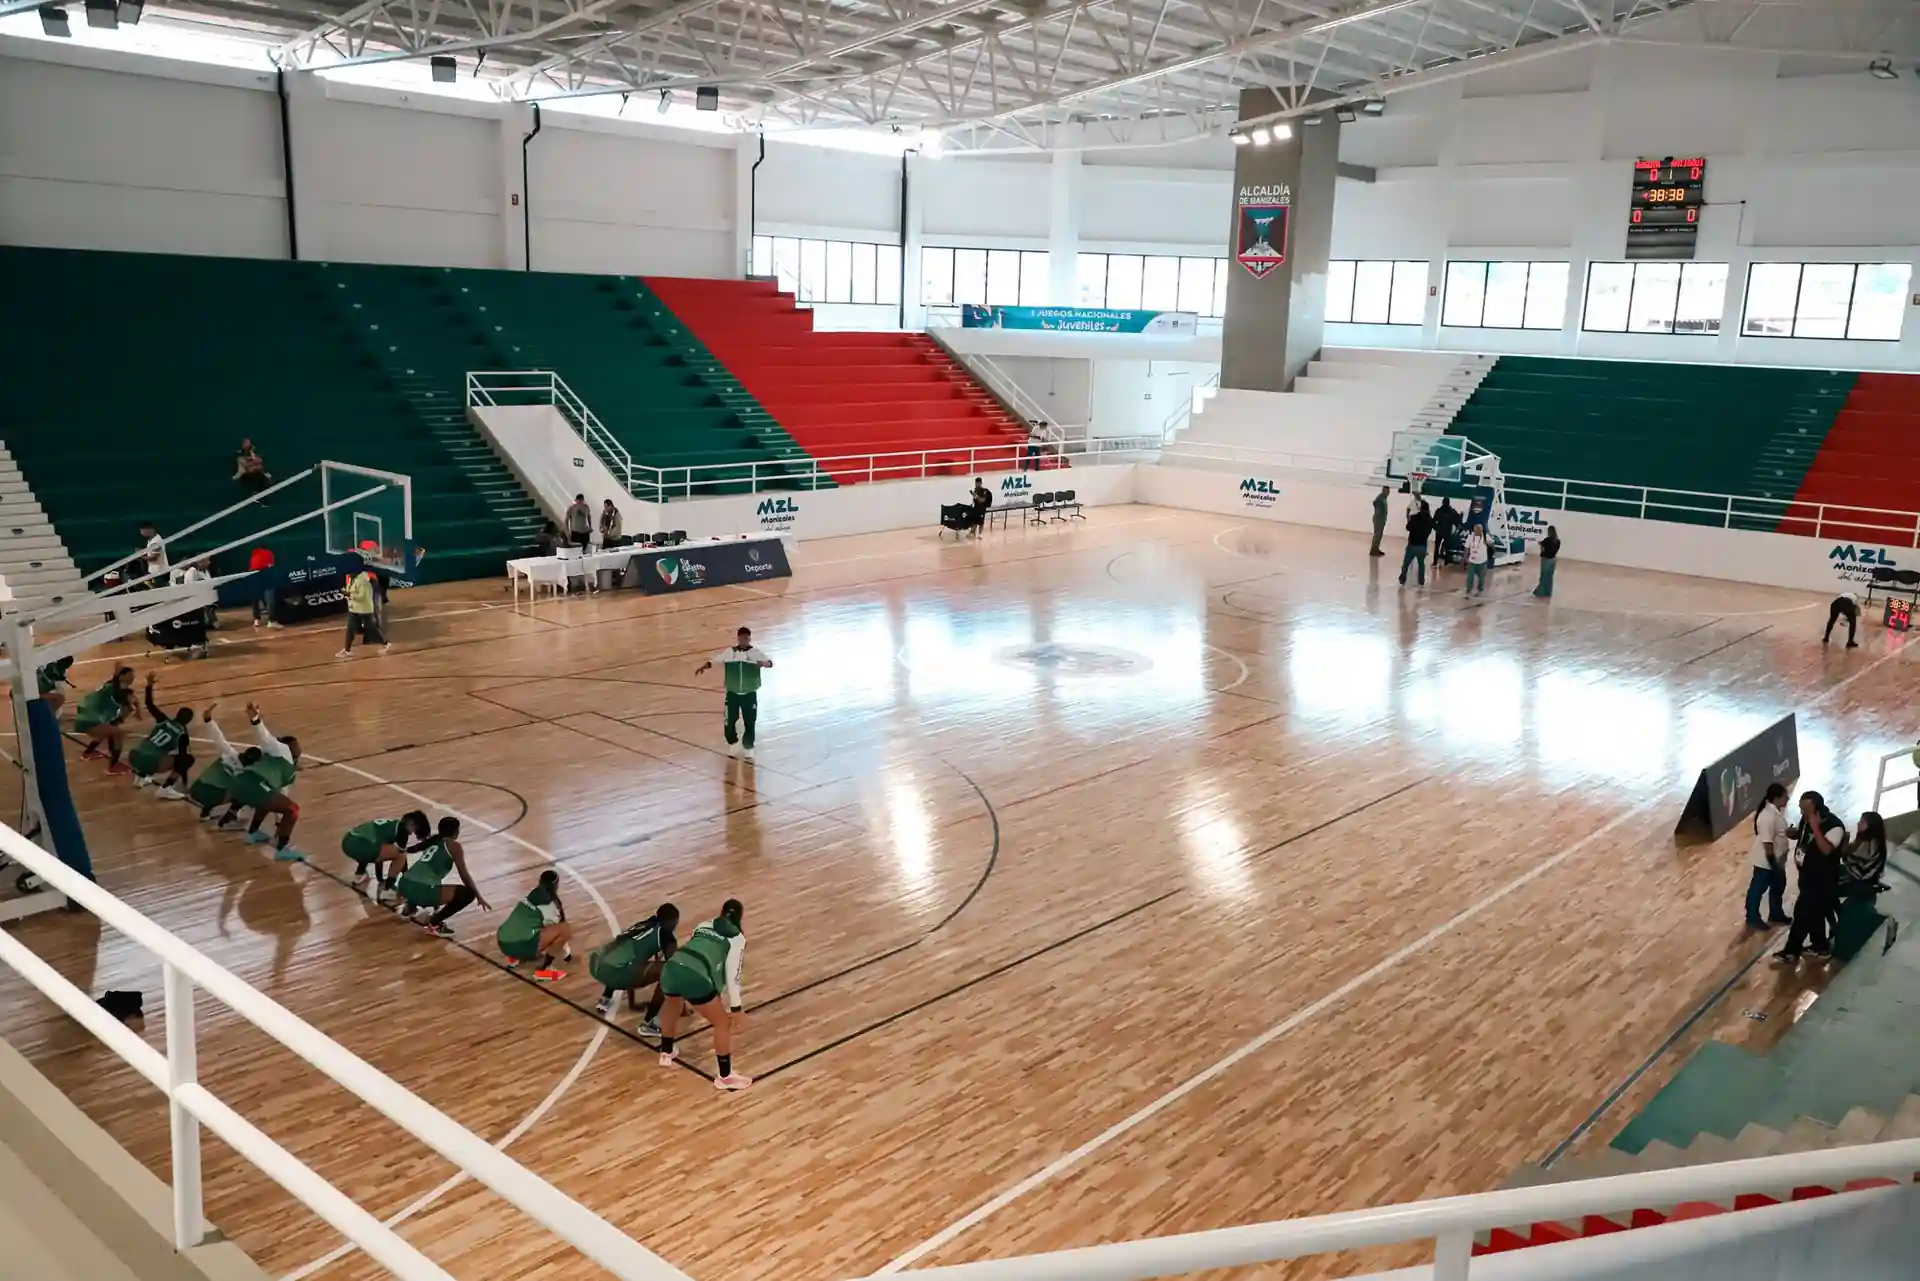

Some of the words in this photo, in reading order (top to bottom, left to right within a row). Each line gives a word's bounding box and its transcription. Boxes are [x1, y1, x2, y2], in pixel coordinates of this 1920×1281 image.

[1649, 168, 1659, 182] 0
[1690, 167, 1700, 181] 0
[1240, 182, 1290, 196] ALCALDÍA
[1649, 188, 1685, 202] 38:38
[1633, 210, 1642, 223] 0
[1687, 209, 1696, 222] 0
[1037, 310, 1073, 318] JUEGOS
[1074, 311, 1132, 320] NACIONALES
[761, 514, 795, 524] Manizales
[1833, 562, 1873, 574] Maniza
[308, 592, 345, 606] CALD
[150, 728, 172, 747] 10
[420, 845, 439, 862] 8
